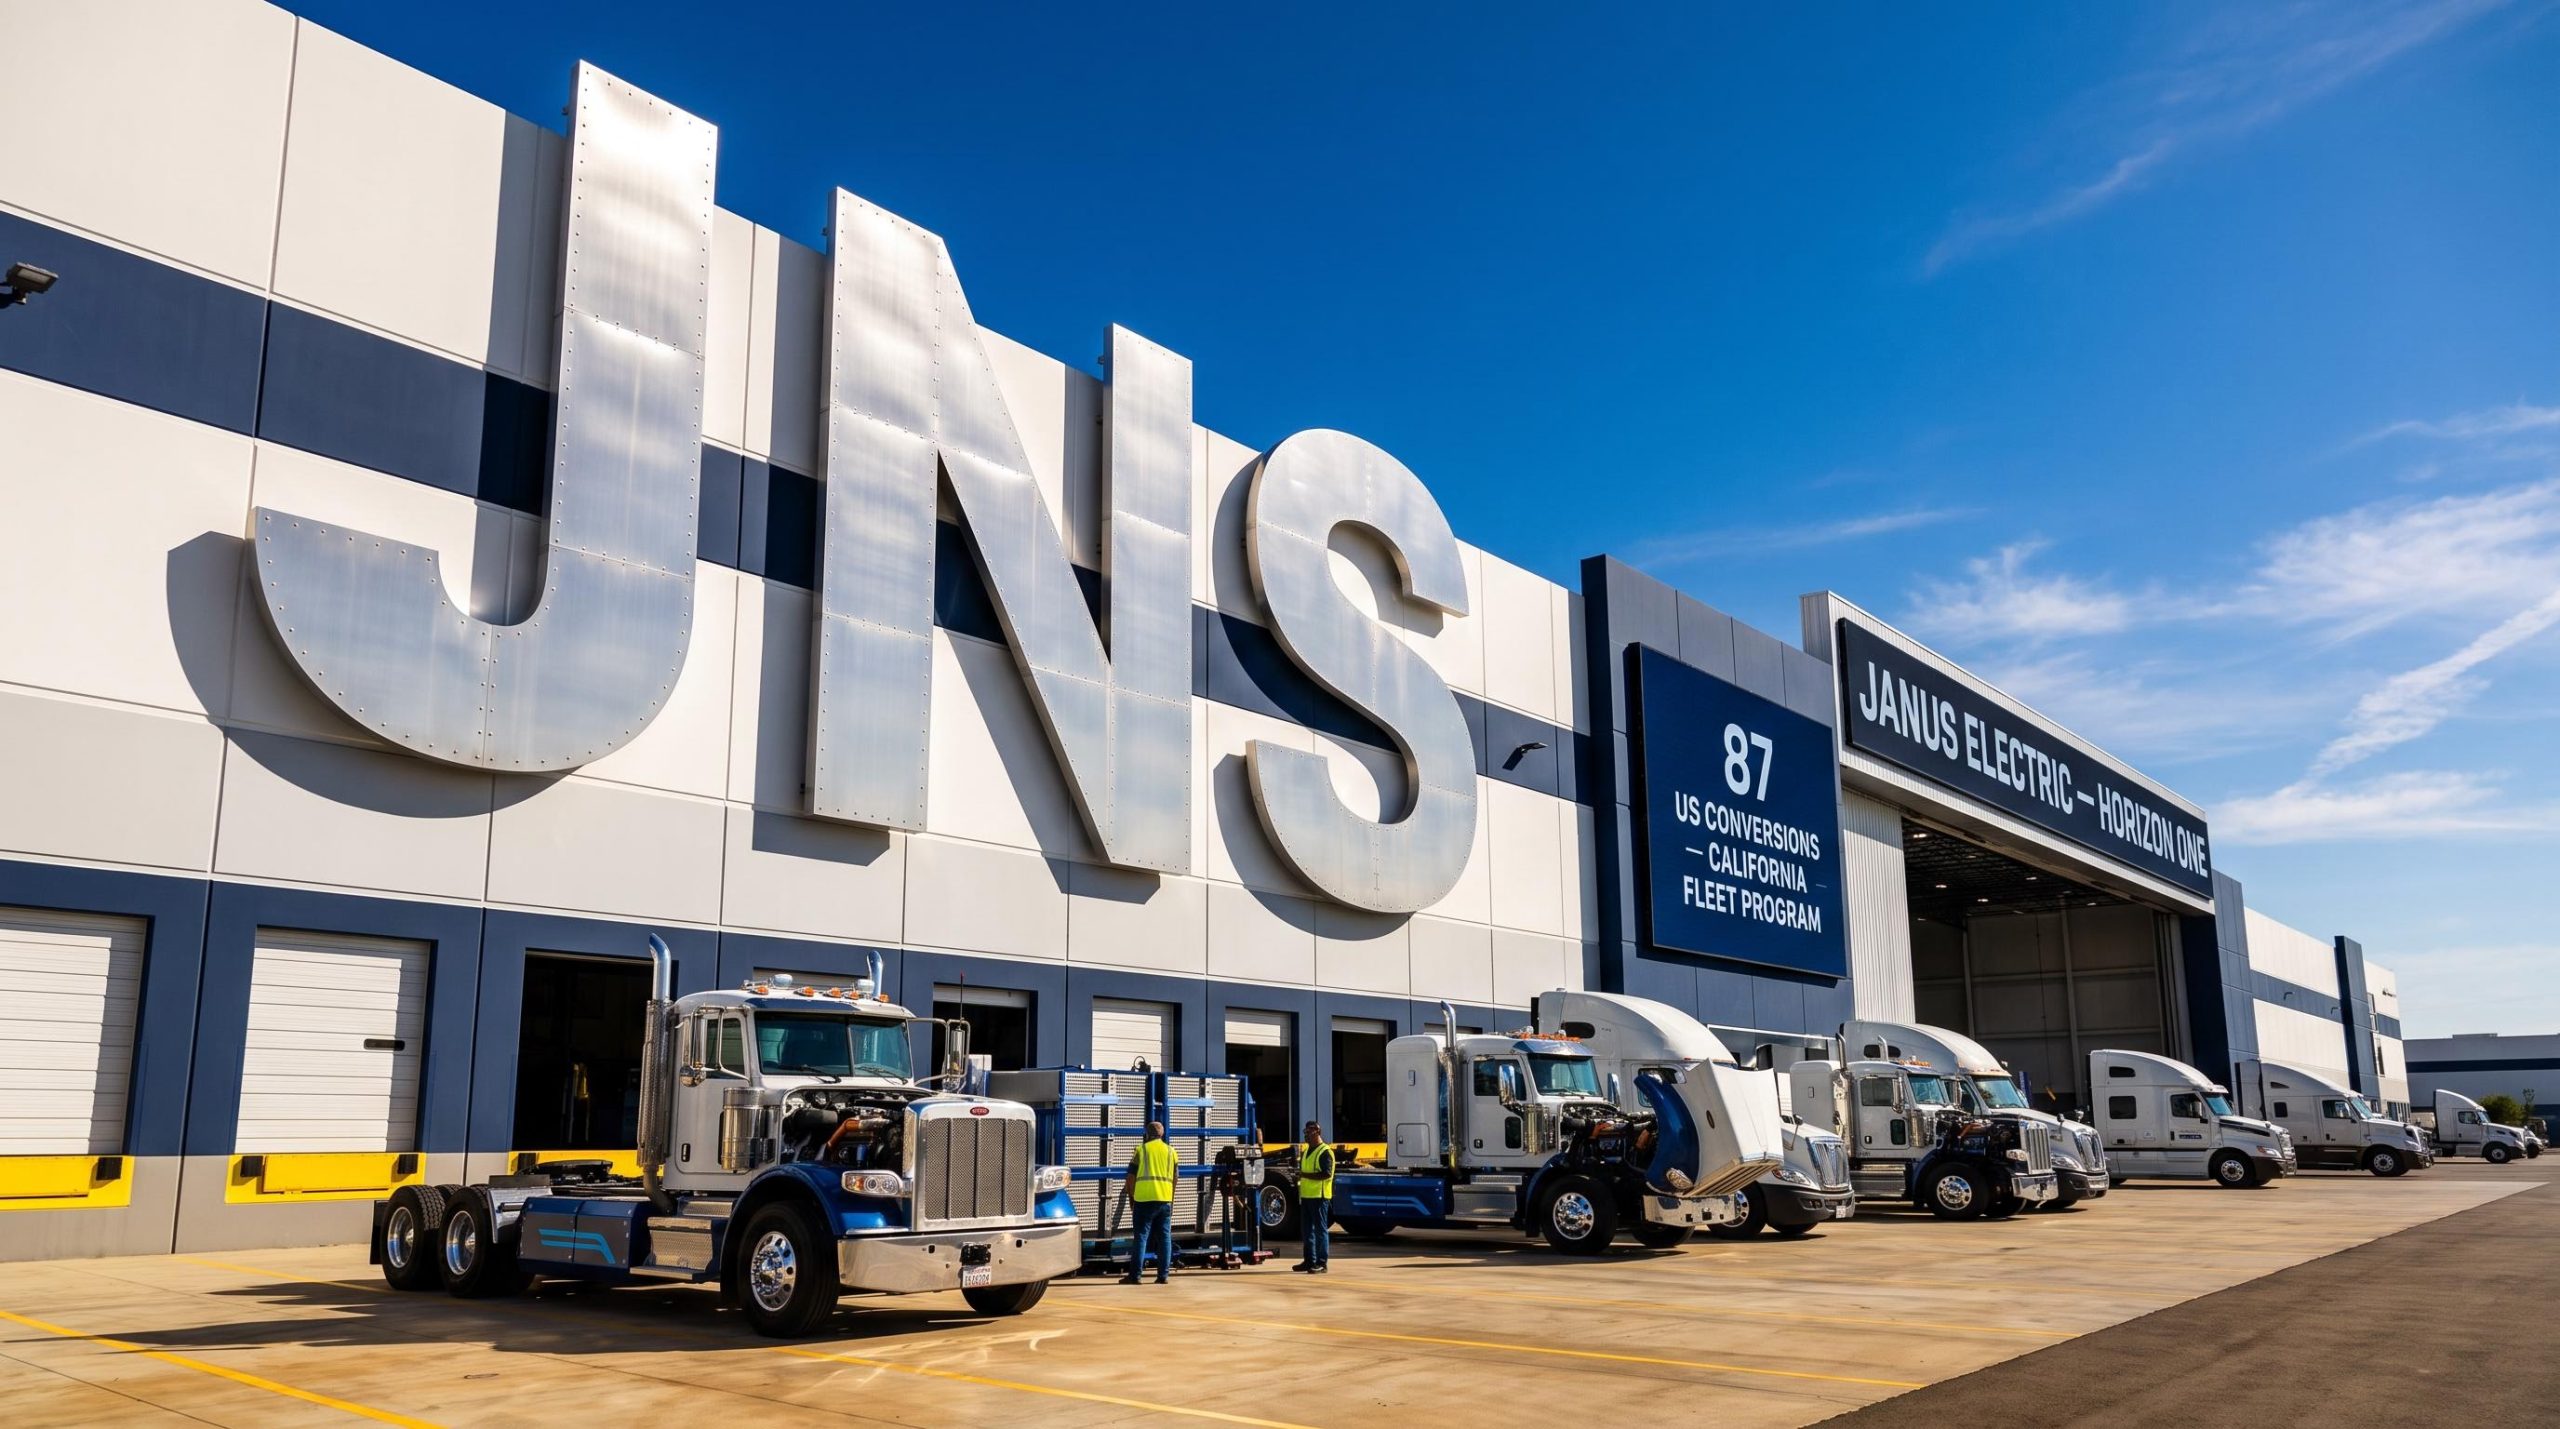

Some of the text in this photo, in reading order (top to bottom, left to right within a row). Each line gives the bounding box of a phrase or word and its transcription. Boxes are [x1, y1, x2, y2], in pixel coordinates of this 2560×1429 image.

[250, 59, 1478, 913] JNS
[1724, 723, 1773, 801] 87
[1859, 661, 1959, 760] JANUS
[1964, 712, 2073, 815] ELECTRIC
[2097, 783, 2176, 863] HORIZON
[2176, 825, 2208, 878] ONE
[1675, 791, 1821, 860] US CONVERSIONS
[1683, 875, 1822, 933] FLEET PROGRAM
[1708, 842, 1808, 893] CALIFORNIA
